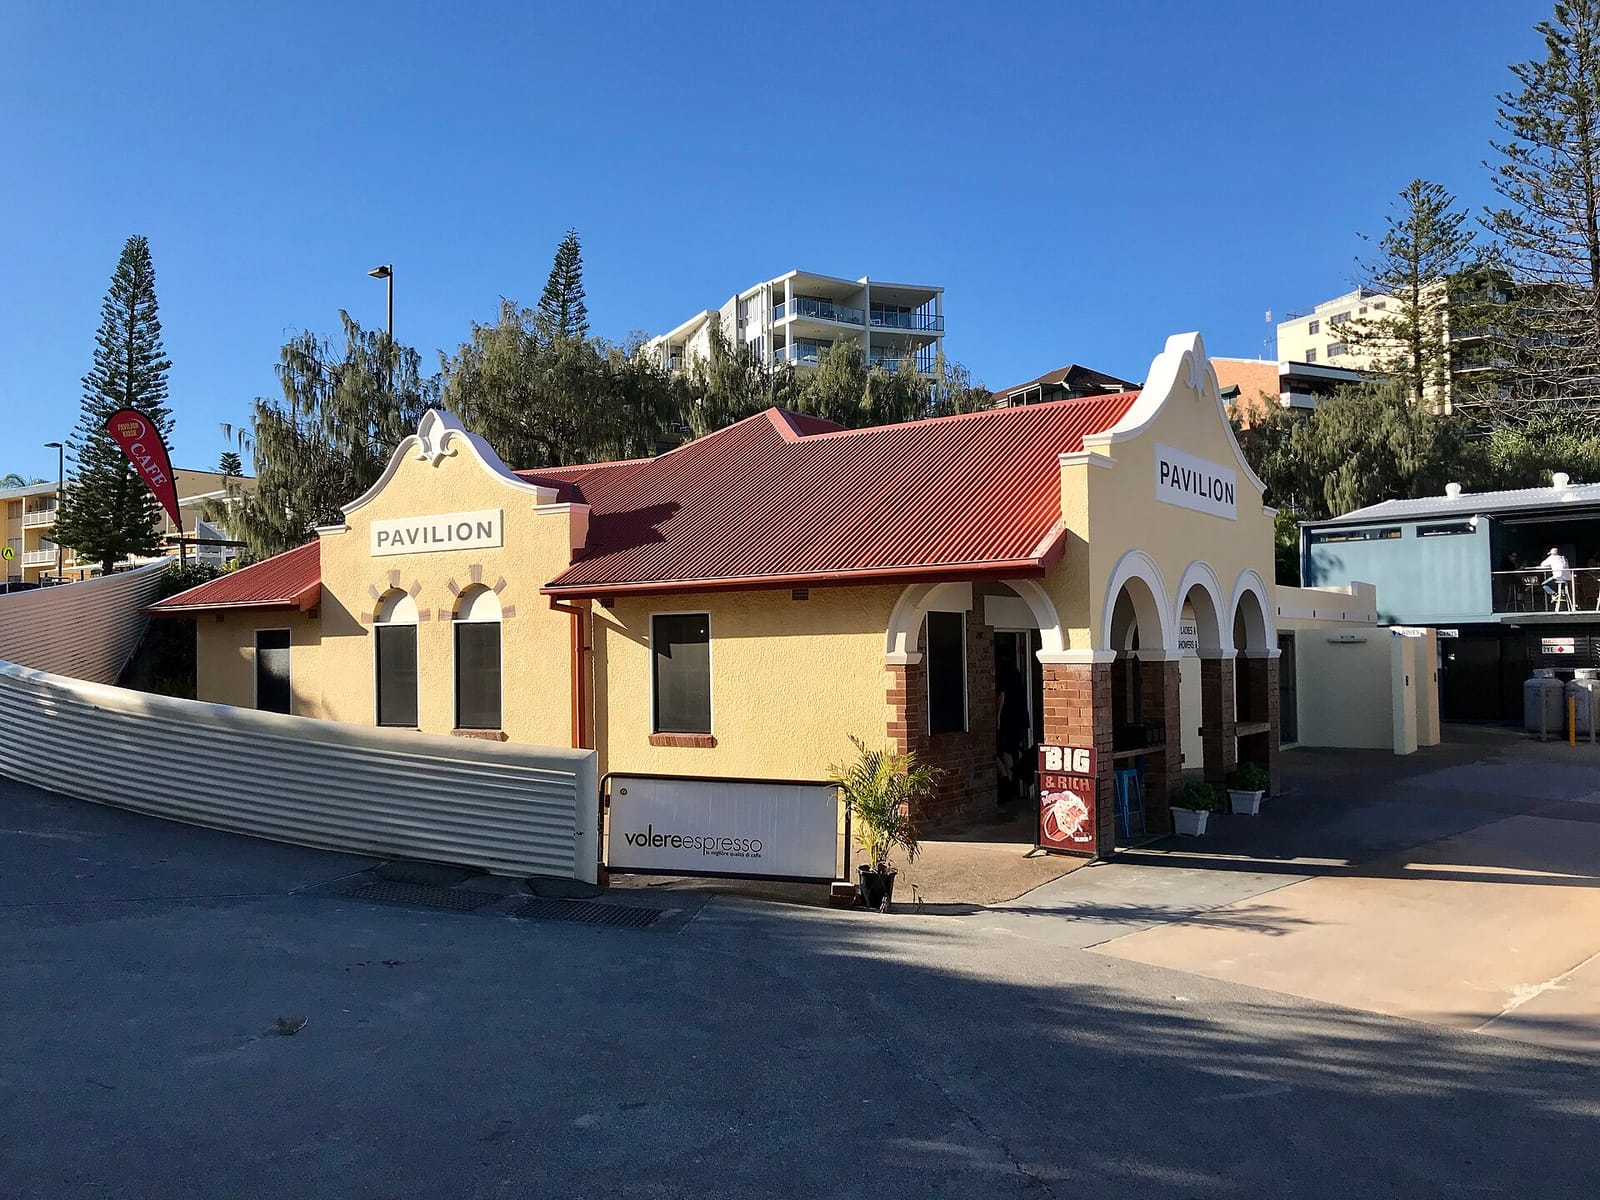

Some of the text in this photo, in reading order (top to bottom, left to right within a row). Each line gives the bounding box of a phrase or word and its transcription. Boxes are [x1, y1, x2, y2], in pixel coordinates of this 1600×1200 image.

[130, 443, 168, 487] CAFE
[1160, 460, 1234, 505] PAVILION
[377, 521, 492, 547] PAVILION
[1039, 746, 1090, 773] BIG
[1045, 775, 1091, 791] & RICH
